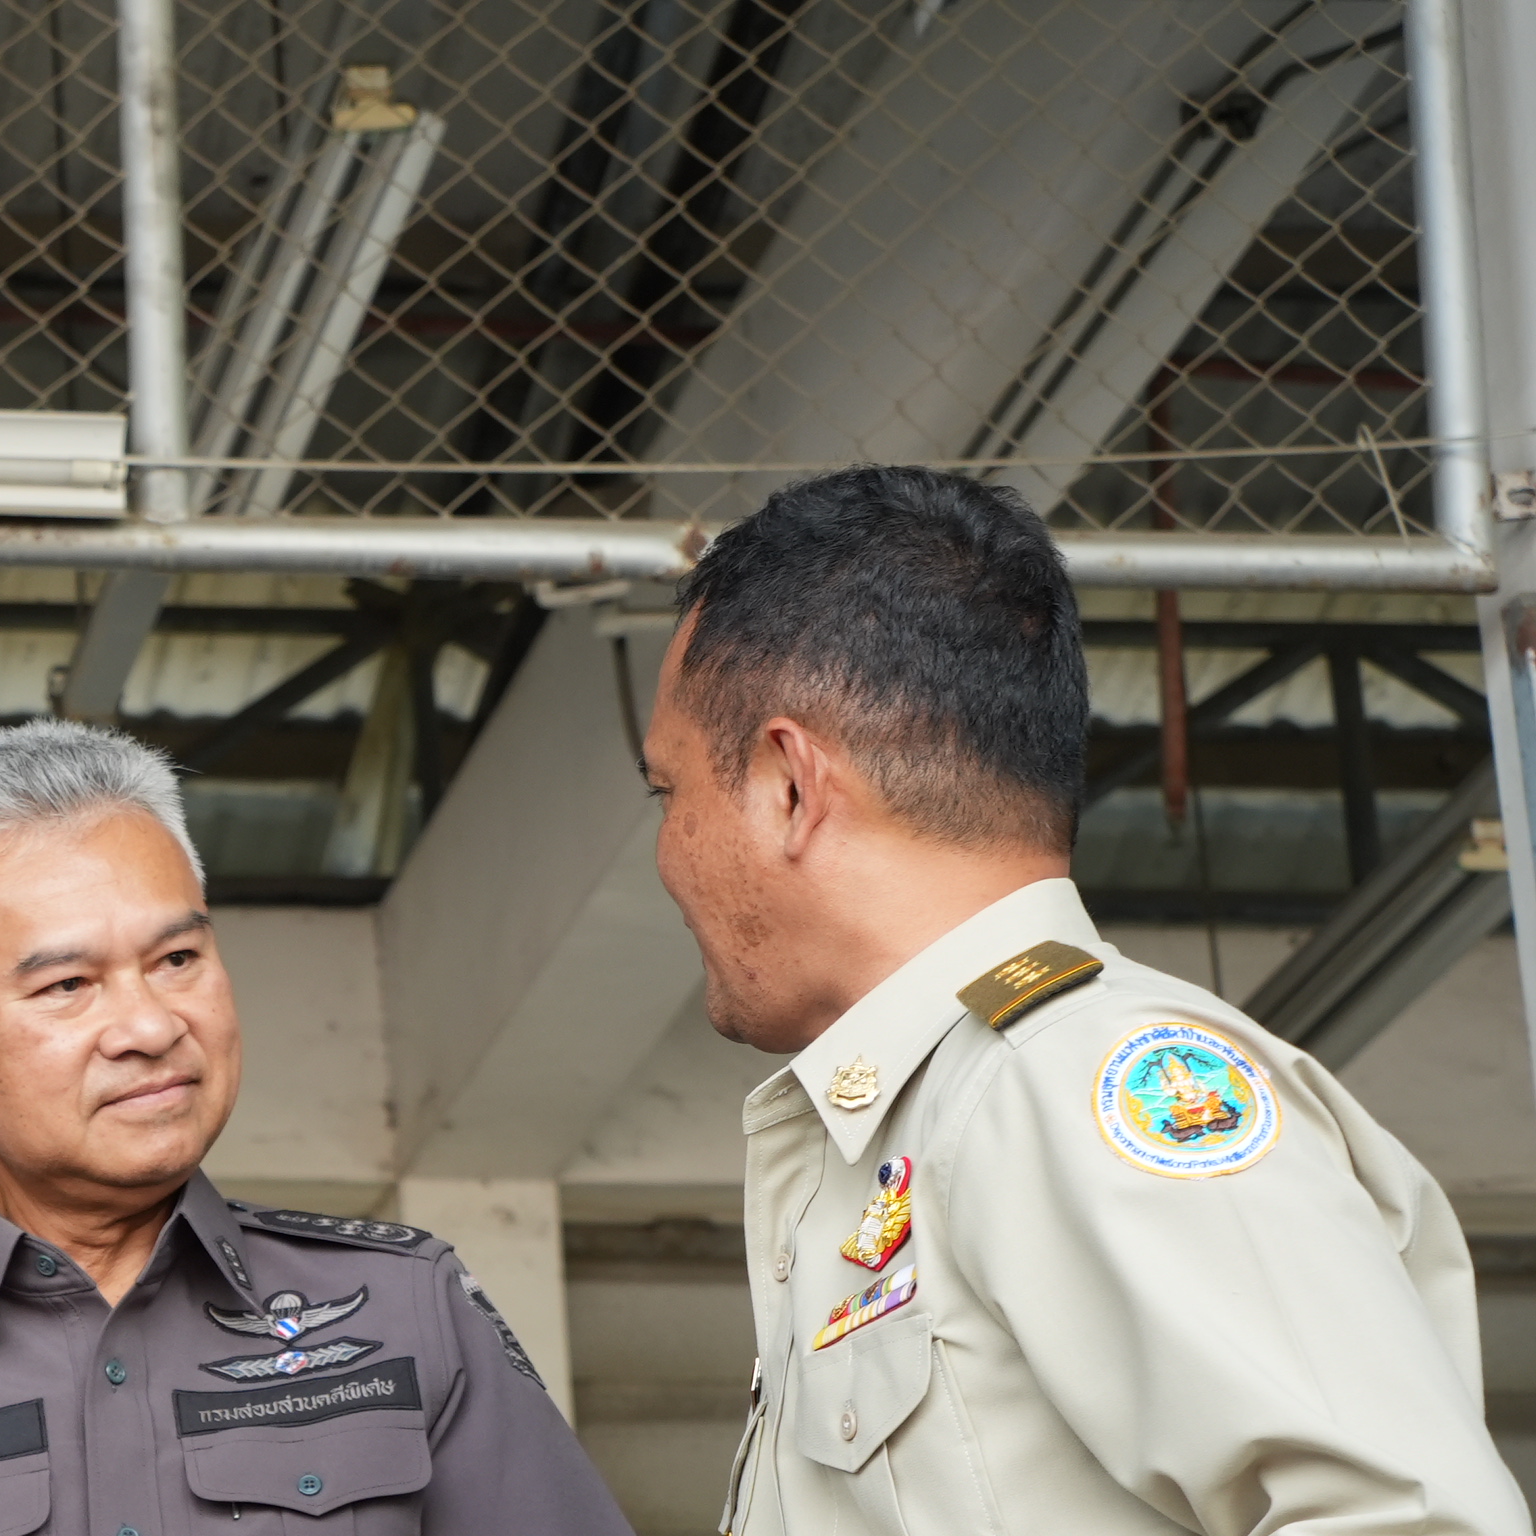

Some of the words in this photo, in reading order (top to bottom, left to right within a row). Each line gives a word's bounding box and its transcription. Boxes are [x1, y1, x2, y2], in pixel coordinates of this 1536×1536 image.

[199, 1378, 397, 1423] กรมสอบสวนคดีพิเศษ
